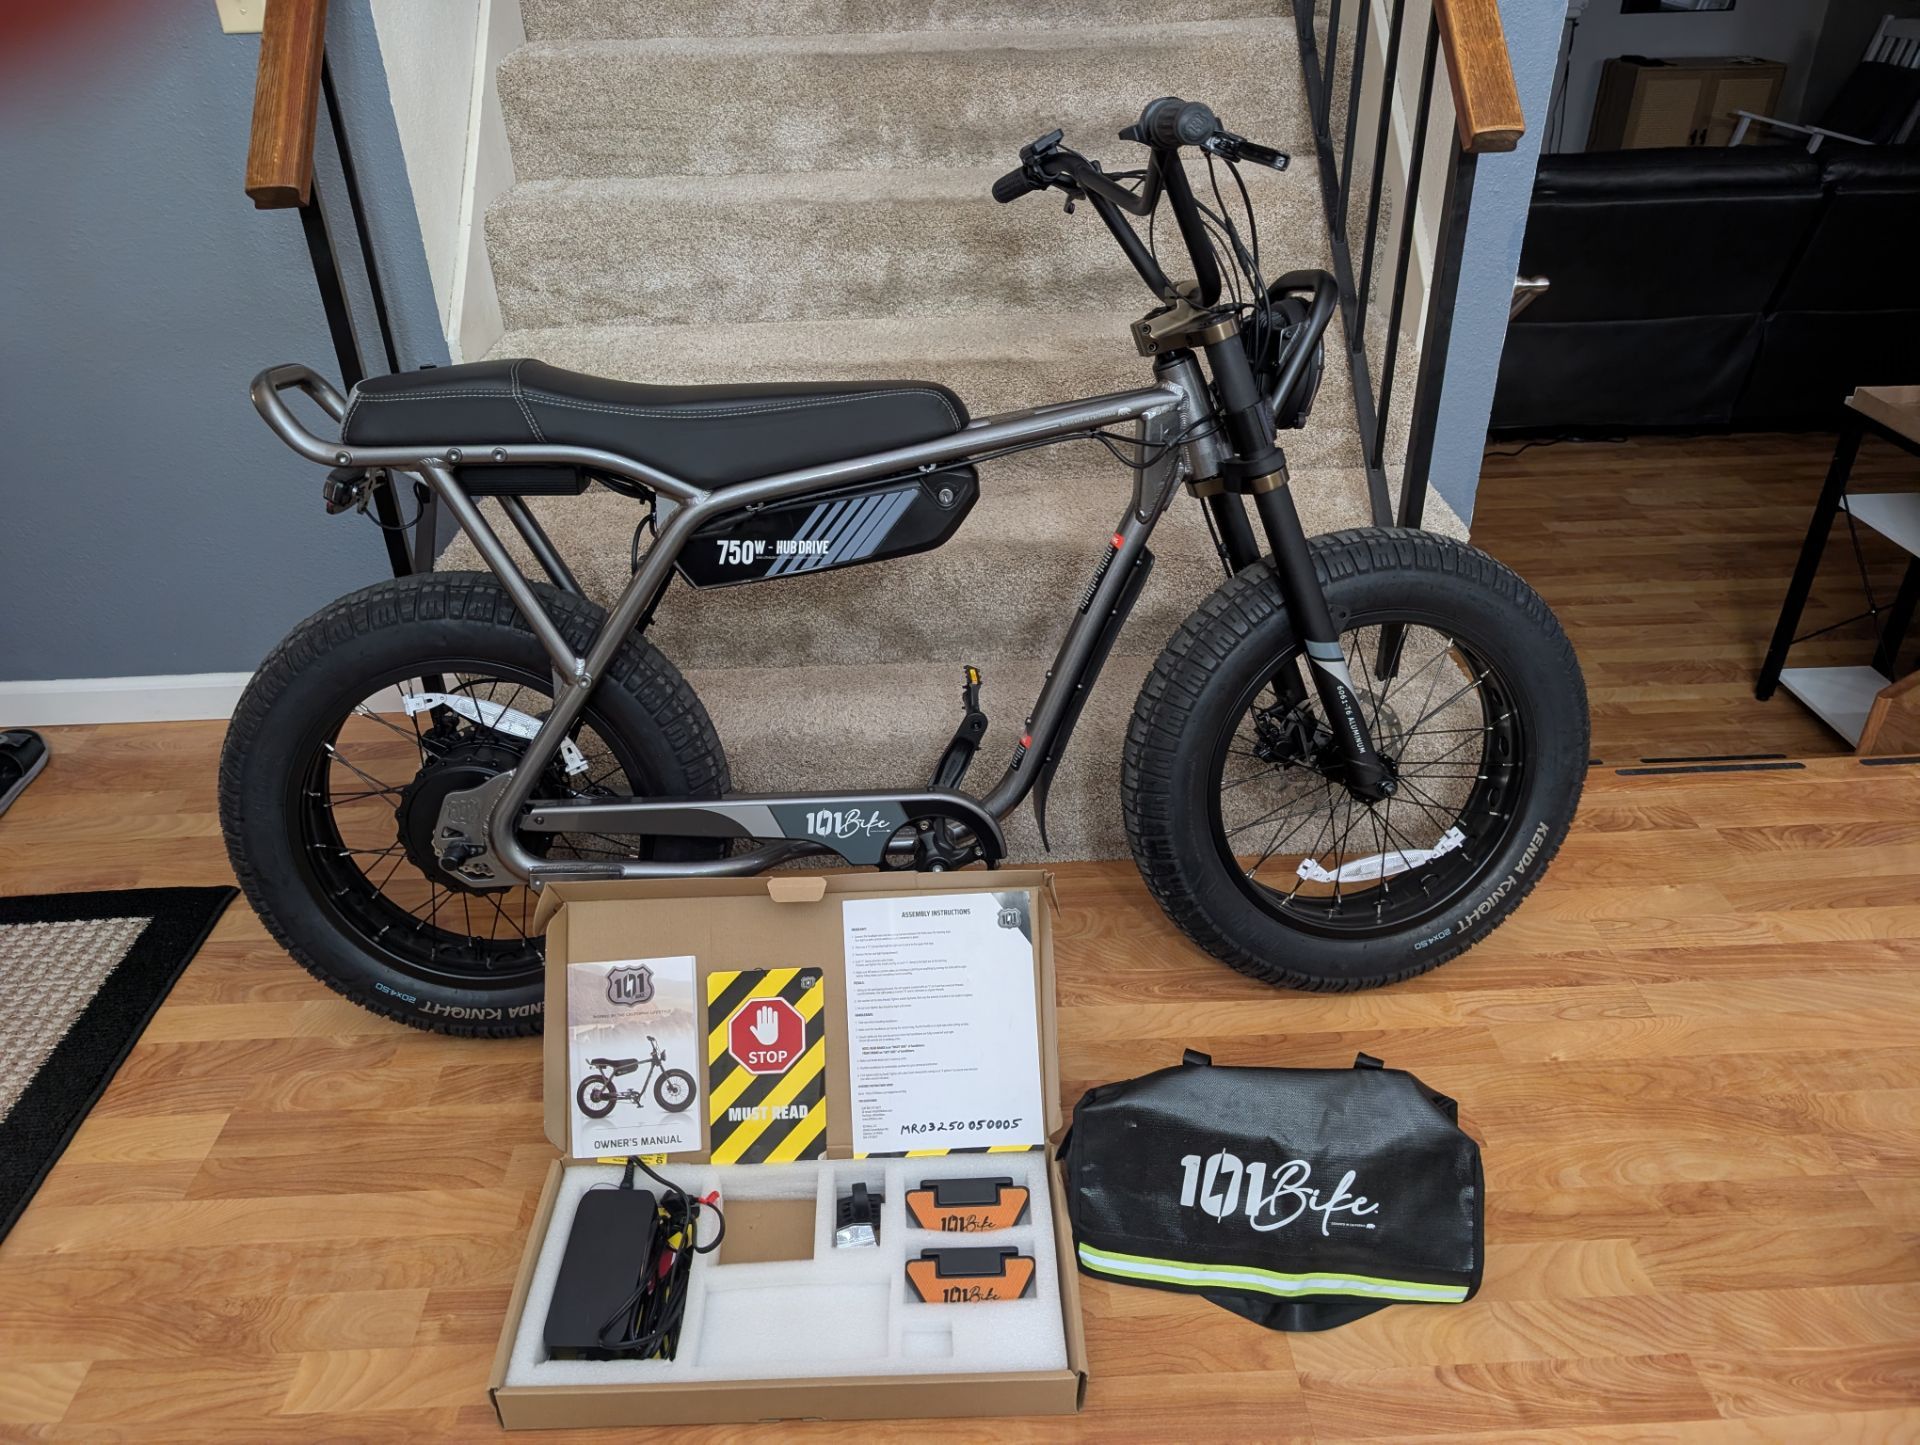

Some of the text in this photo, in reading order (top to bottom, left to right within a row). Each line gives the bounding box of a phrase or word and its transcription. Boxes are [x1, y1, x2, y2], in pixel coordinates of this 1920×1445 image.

[716, 539, 766, 565] 750W
[776, 539, 798, 555] HUB
[798, 539, 830, 555] DRIVE
[1336, 685, 1367, 754] 6061-T6 ALUMINUM
[1514, 821, 1550, 874] KENDA
[901, 908, 971, 918] ASSEMBLY INSTRUCTIONS
[1457, 875, 1518, 934] KNIGHT
[614, 972, 645, 999] 101
[418, 1000, 502, 1020] KNIGHT
[748, 1050, 788, 1064] STOP
[728, 1104, 809, 1122] MUST READ
[594, 1134, 683, 1149] OWNER'S MANUAL
